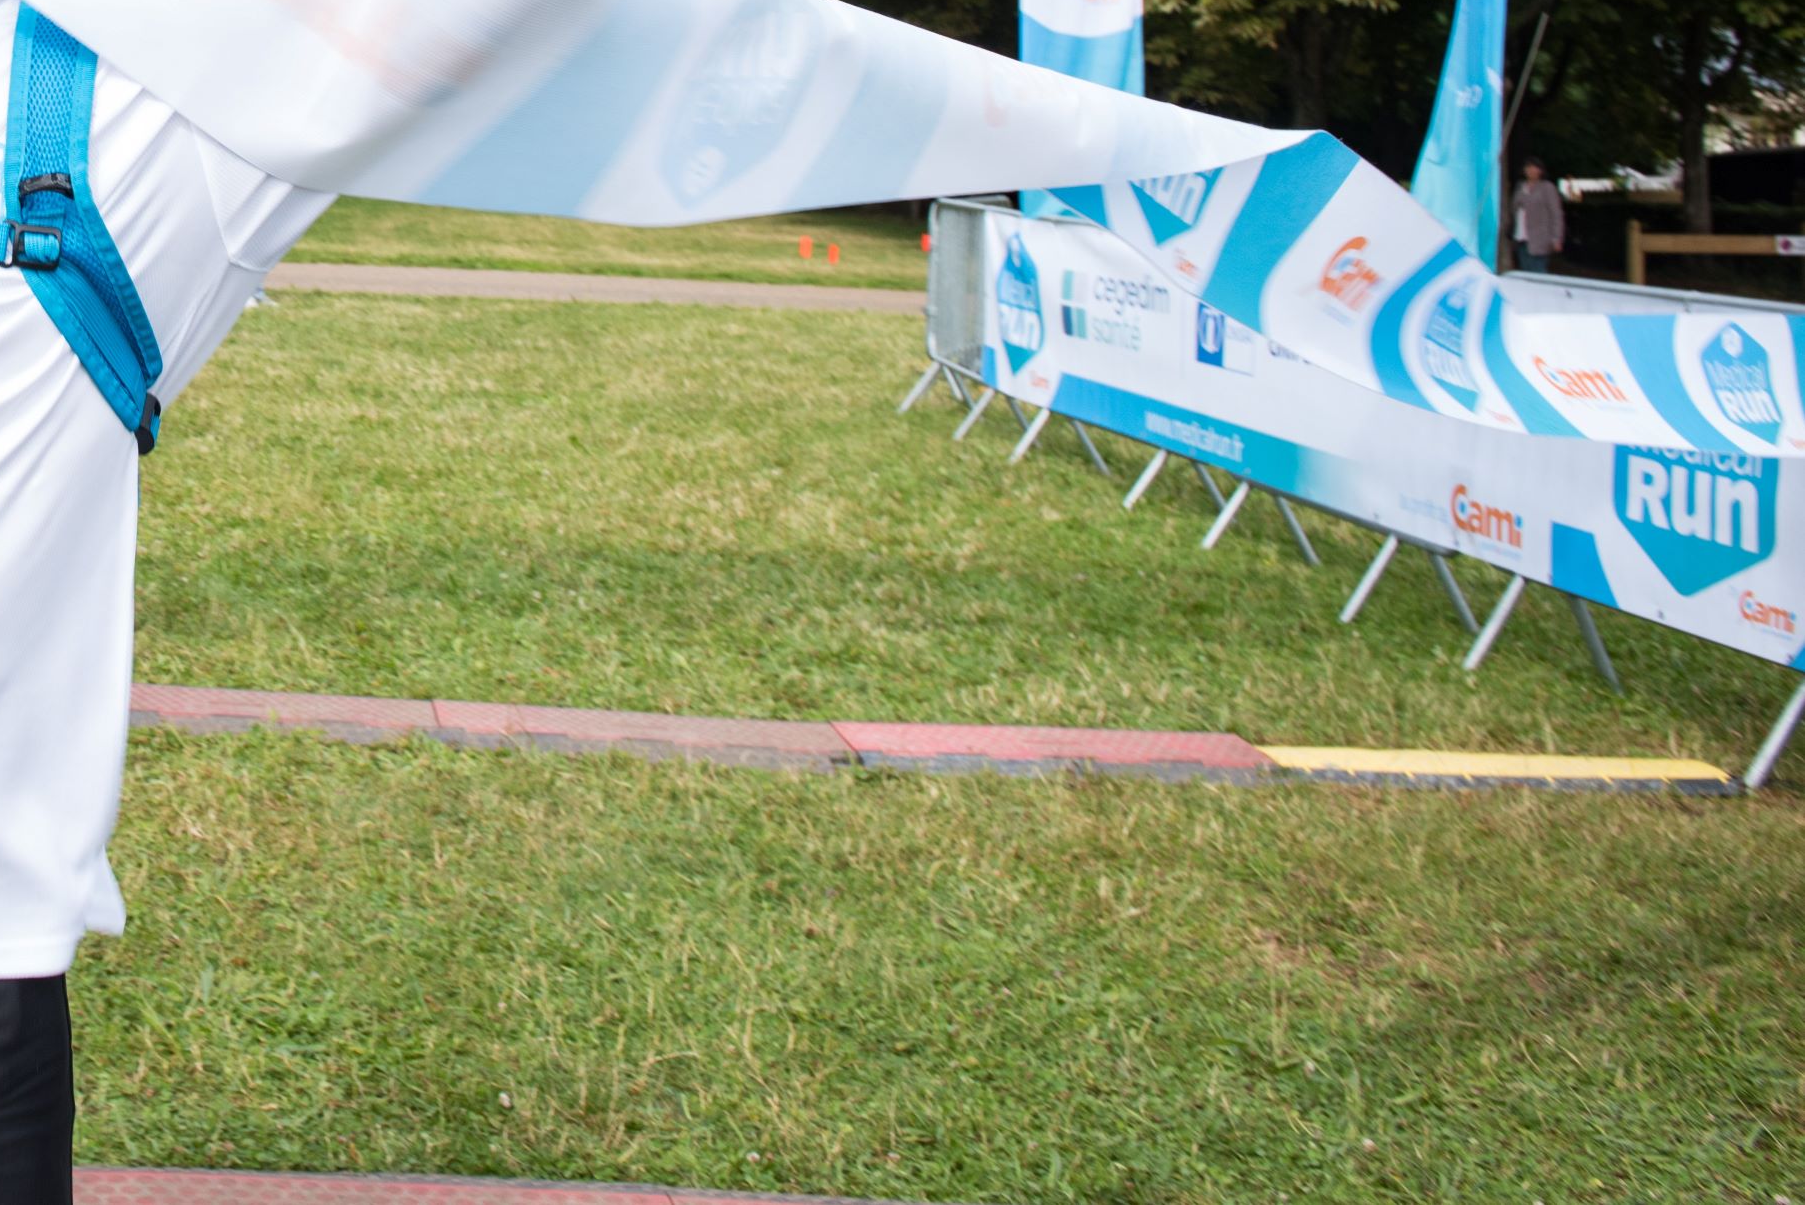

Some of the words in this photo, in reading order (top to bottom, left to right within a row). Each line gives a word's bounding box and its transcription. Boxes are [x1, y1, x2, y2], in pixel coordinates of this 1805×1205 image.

[1094, 272, 1172, 316] cegedim
[1532, 354, 1628, 403] Cami
[1715, 388, 1782, 425] Run
[1451, 483, 1523, 550] Cami
[1625, 453, 1760, 555] Run
[1738, 590, 1798, 635] Cami
